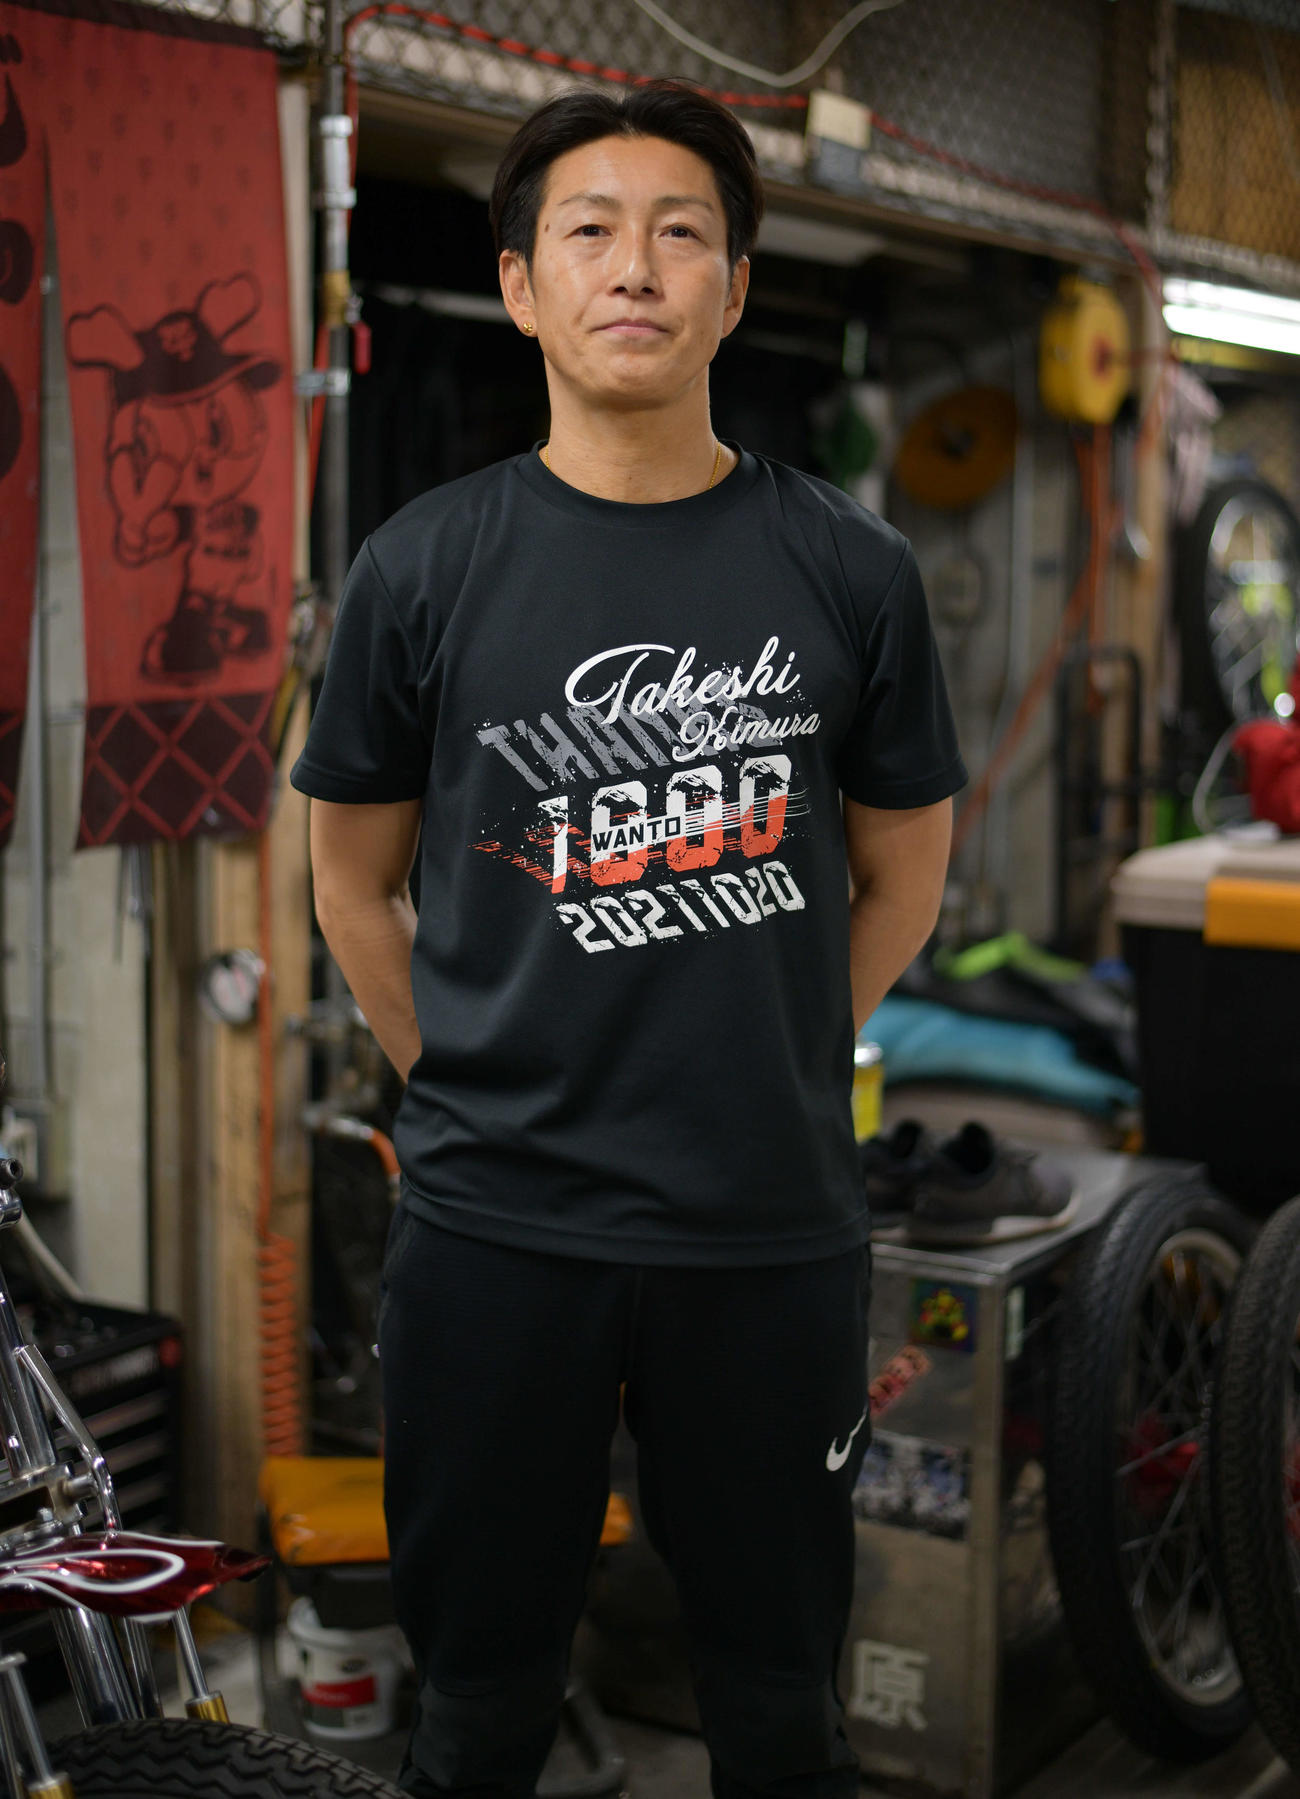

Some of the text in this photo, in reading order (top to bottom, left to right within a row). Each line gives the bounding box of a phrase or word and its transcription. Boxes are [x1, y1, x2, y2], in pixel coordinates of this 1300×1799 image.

[565, 635, 800, 725] Takeshi
[671, 706, 821, 762] Kimura
[556, 860, 805, 953] 20211020
[852, 1639, 929, 1731] 原
